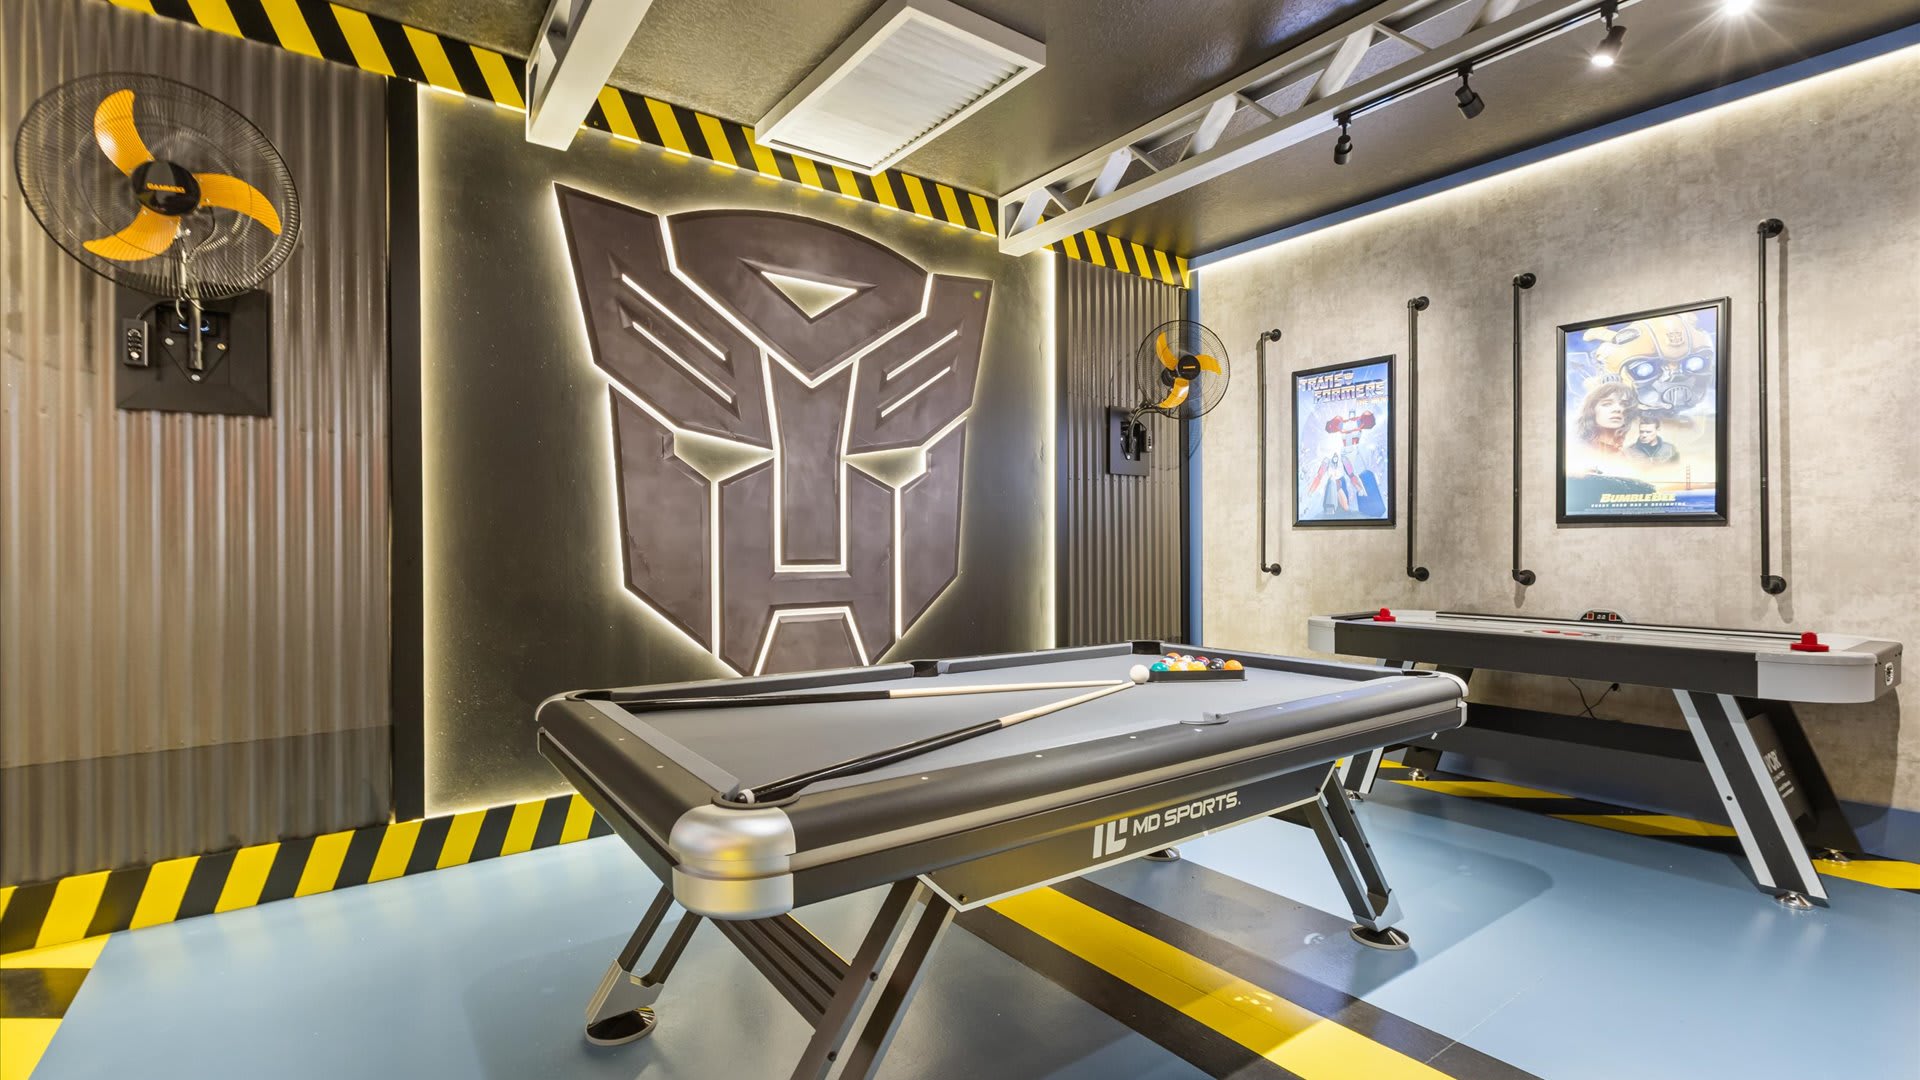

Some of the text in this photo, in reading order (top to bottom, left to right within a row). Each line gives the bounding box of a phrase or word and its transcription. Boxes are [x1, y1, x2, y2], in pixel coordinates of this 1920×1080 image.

[1313, 382, 1385, 402] FORMERS
[1600, 492, 1676, 502] BUMBLEBEE
[1132, 813, 1161, 837] MD
